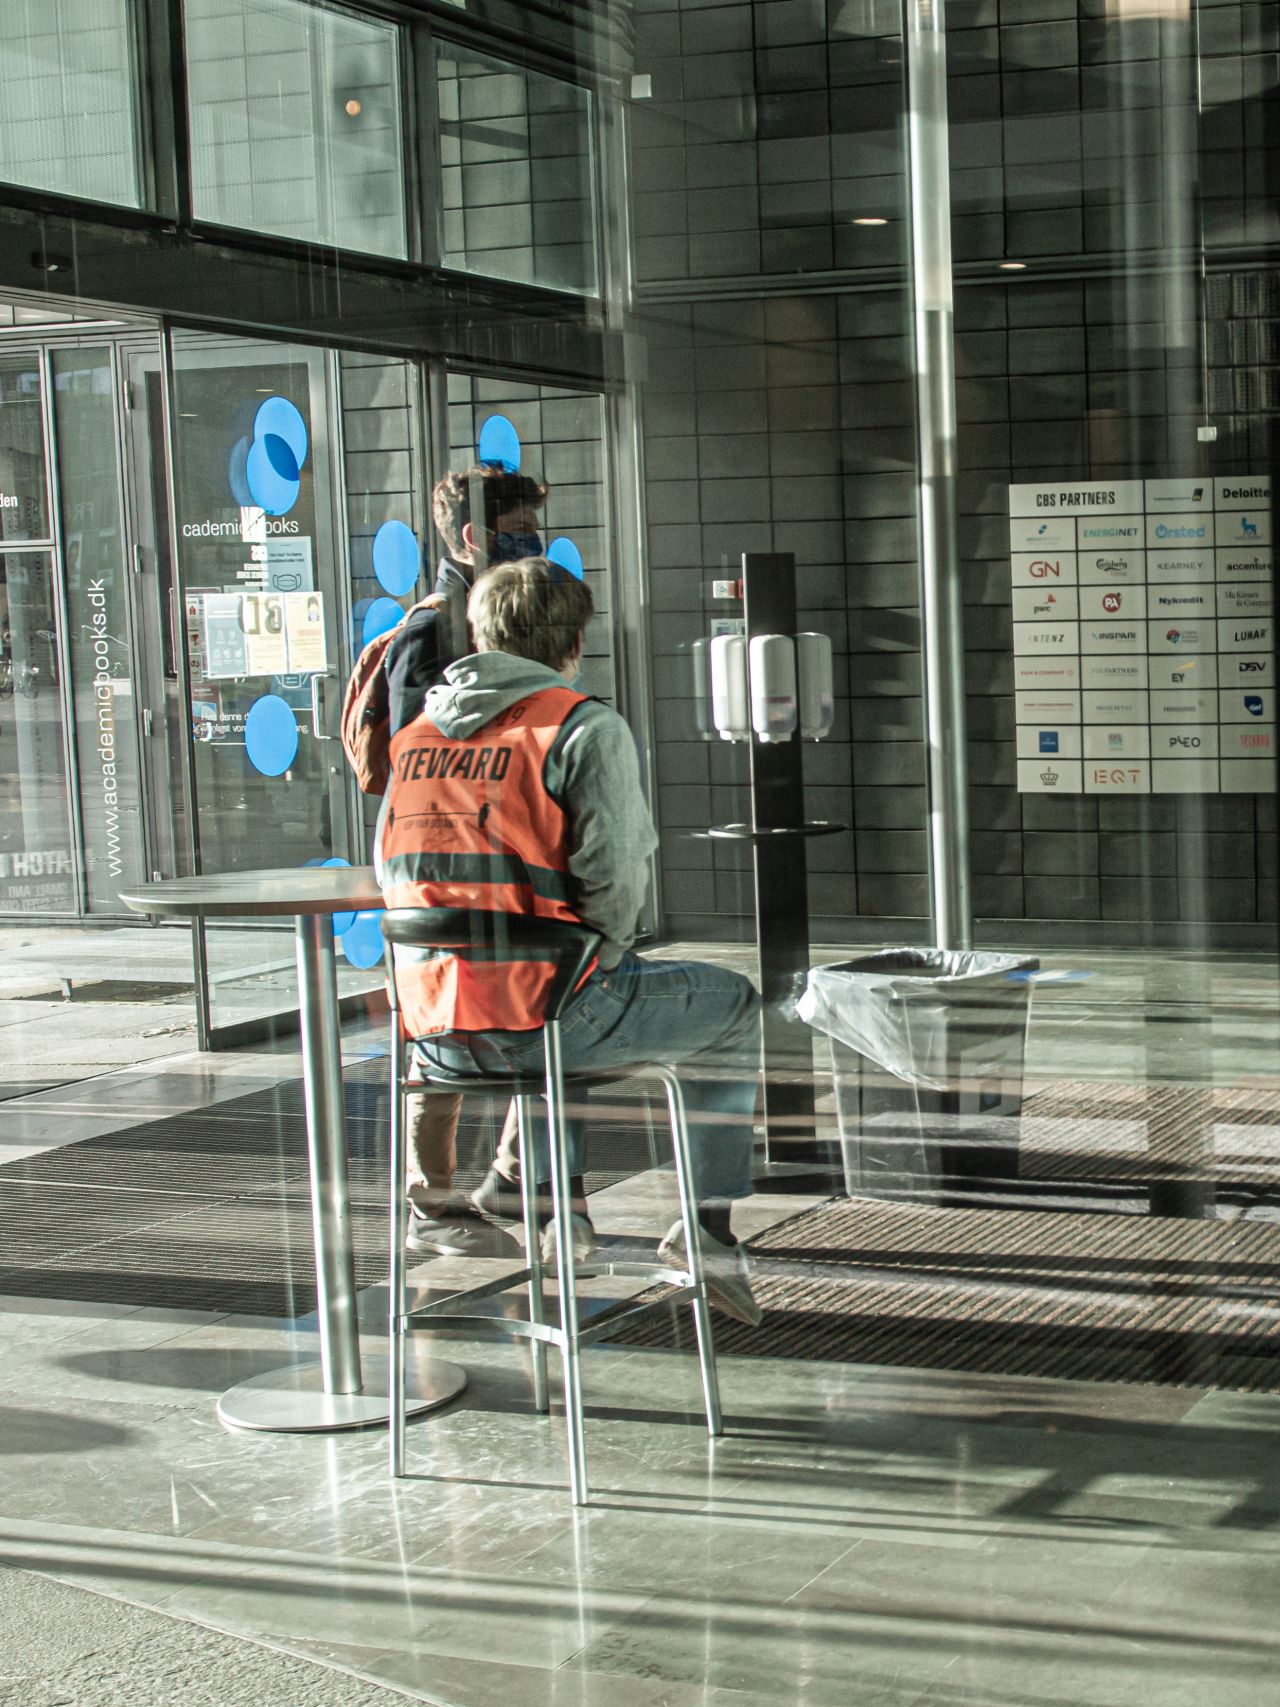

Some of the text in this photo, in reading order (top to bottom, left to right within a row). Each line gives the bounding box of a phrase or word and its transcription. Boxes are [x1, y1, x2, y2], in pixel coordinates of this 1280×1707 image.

[1222, 487, 1271, 498] Deloitte
[0, 495, 18, 508] den
[1036, 491, 1115, 507] CBS PARTNERS
[182, 517, 300, 537] cademic ooks
[1083, 528, 1138, 538] ENERGINET
[1029, 561, 1059, 577] GN
[1157, 562, 1203, 570] KEARNEY
[1226, 562, 1272, 571] accenture
[1159, 597, 1203, 606] Nykredit
[1033, 605, 1051, 614] pwc
[1028, 634, 1064, 643] INTENZ
[1234, 629, 1266, 642] LUNAR
[1238, 662, 1266, 672] DSV
[1171, 673, 1185, 682] EY
[88, 578, 123, 877] www.academicbooks.dk
[1094, 769, 1141, 784] EQT
